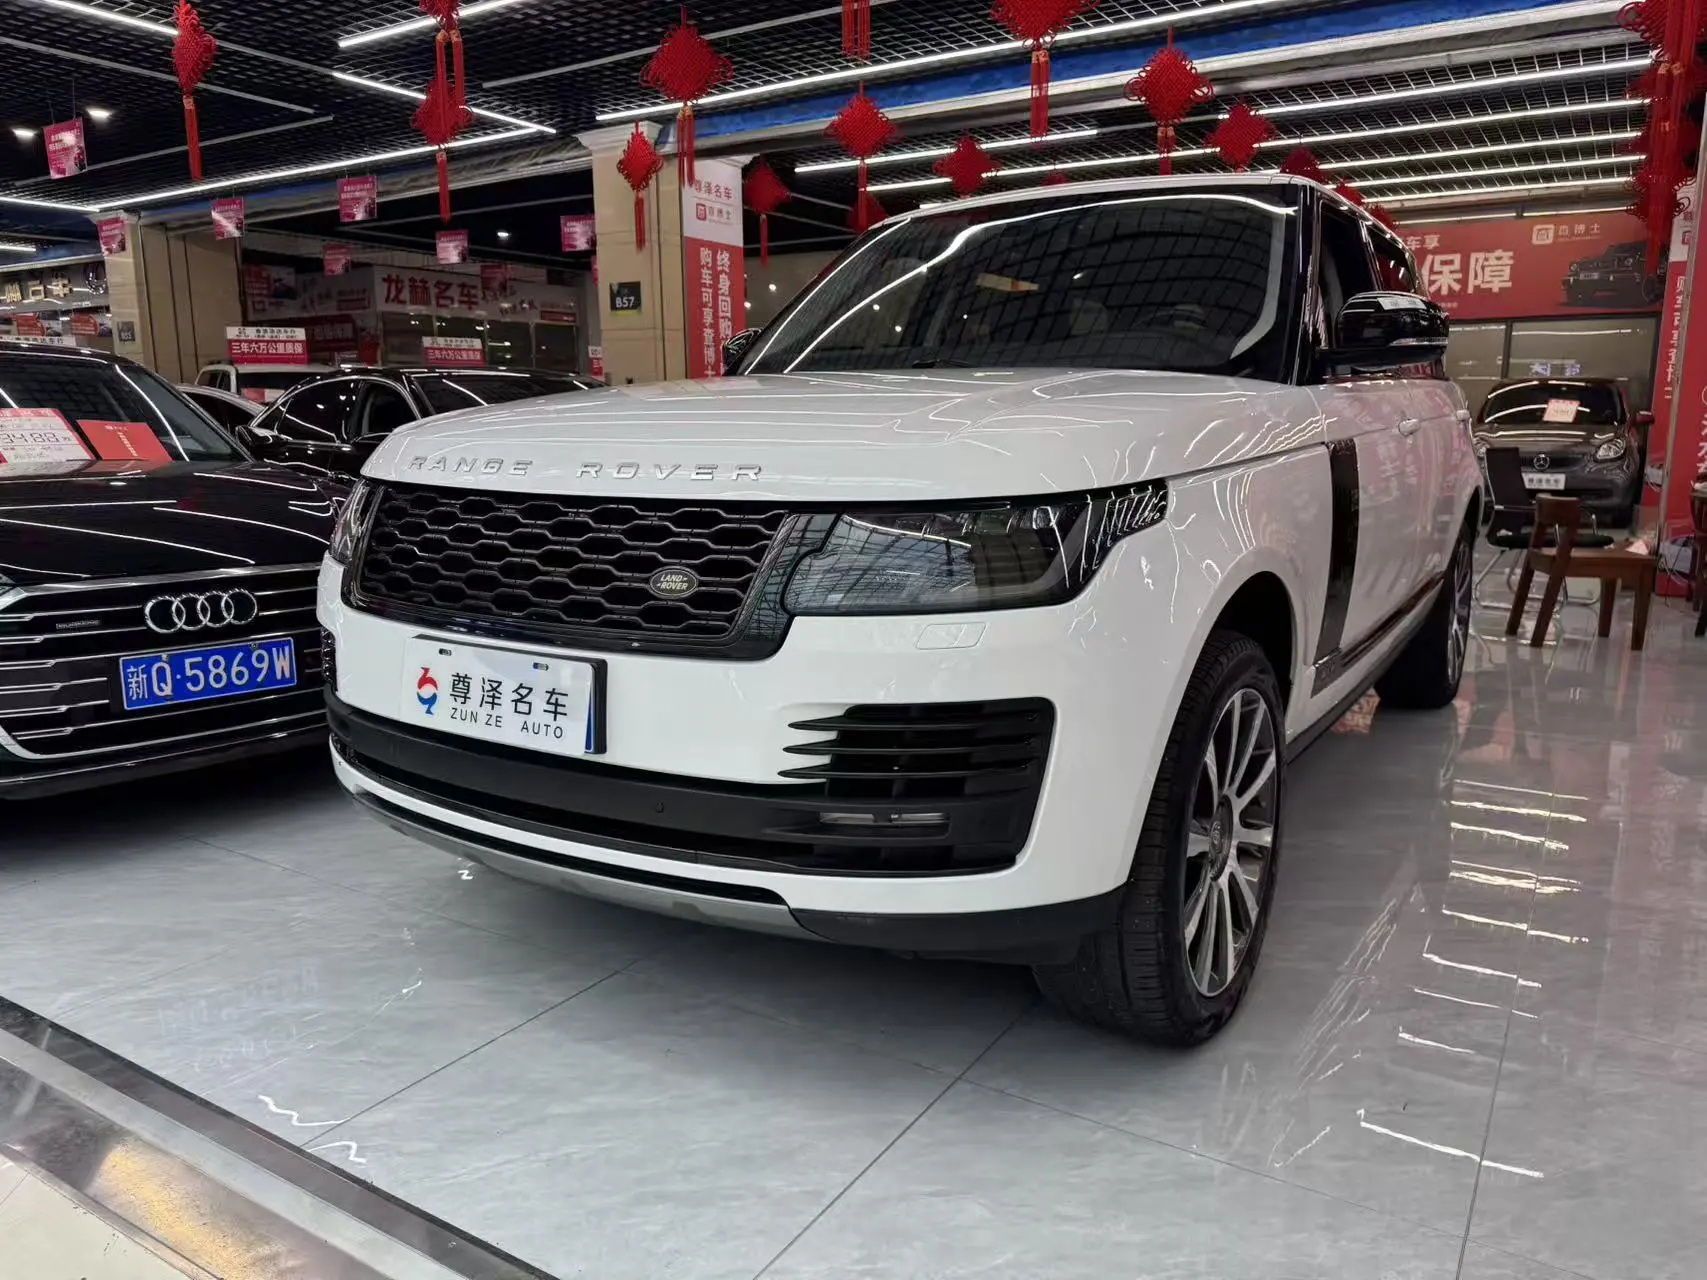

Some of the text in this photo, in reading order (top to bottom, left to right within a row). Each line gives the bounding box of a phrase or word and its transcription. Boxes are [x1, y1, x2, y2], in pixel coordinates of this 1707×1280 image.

[1401, 234, 1441, 251] 车享
[1421, 249, 1514, 296] 保障
[615, 296, 635, 308] B57
[406, 456, 762, 481] RANGE ROVER
[450, 672, 569, 722] 尊泽名车
[450, 707, 564, 739] ZUN ZE AUTO
